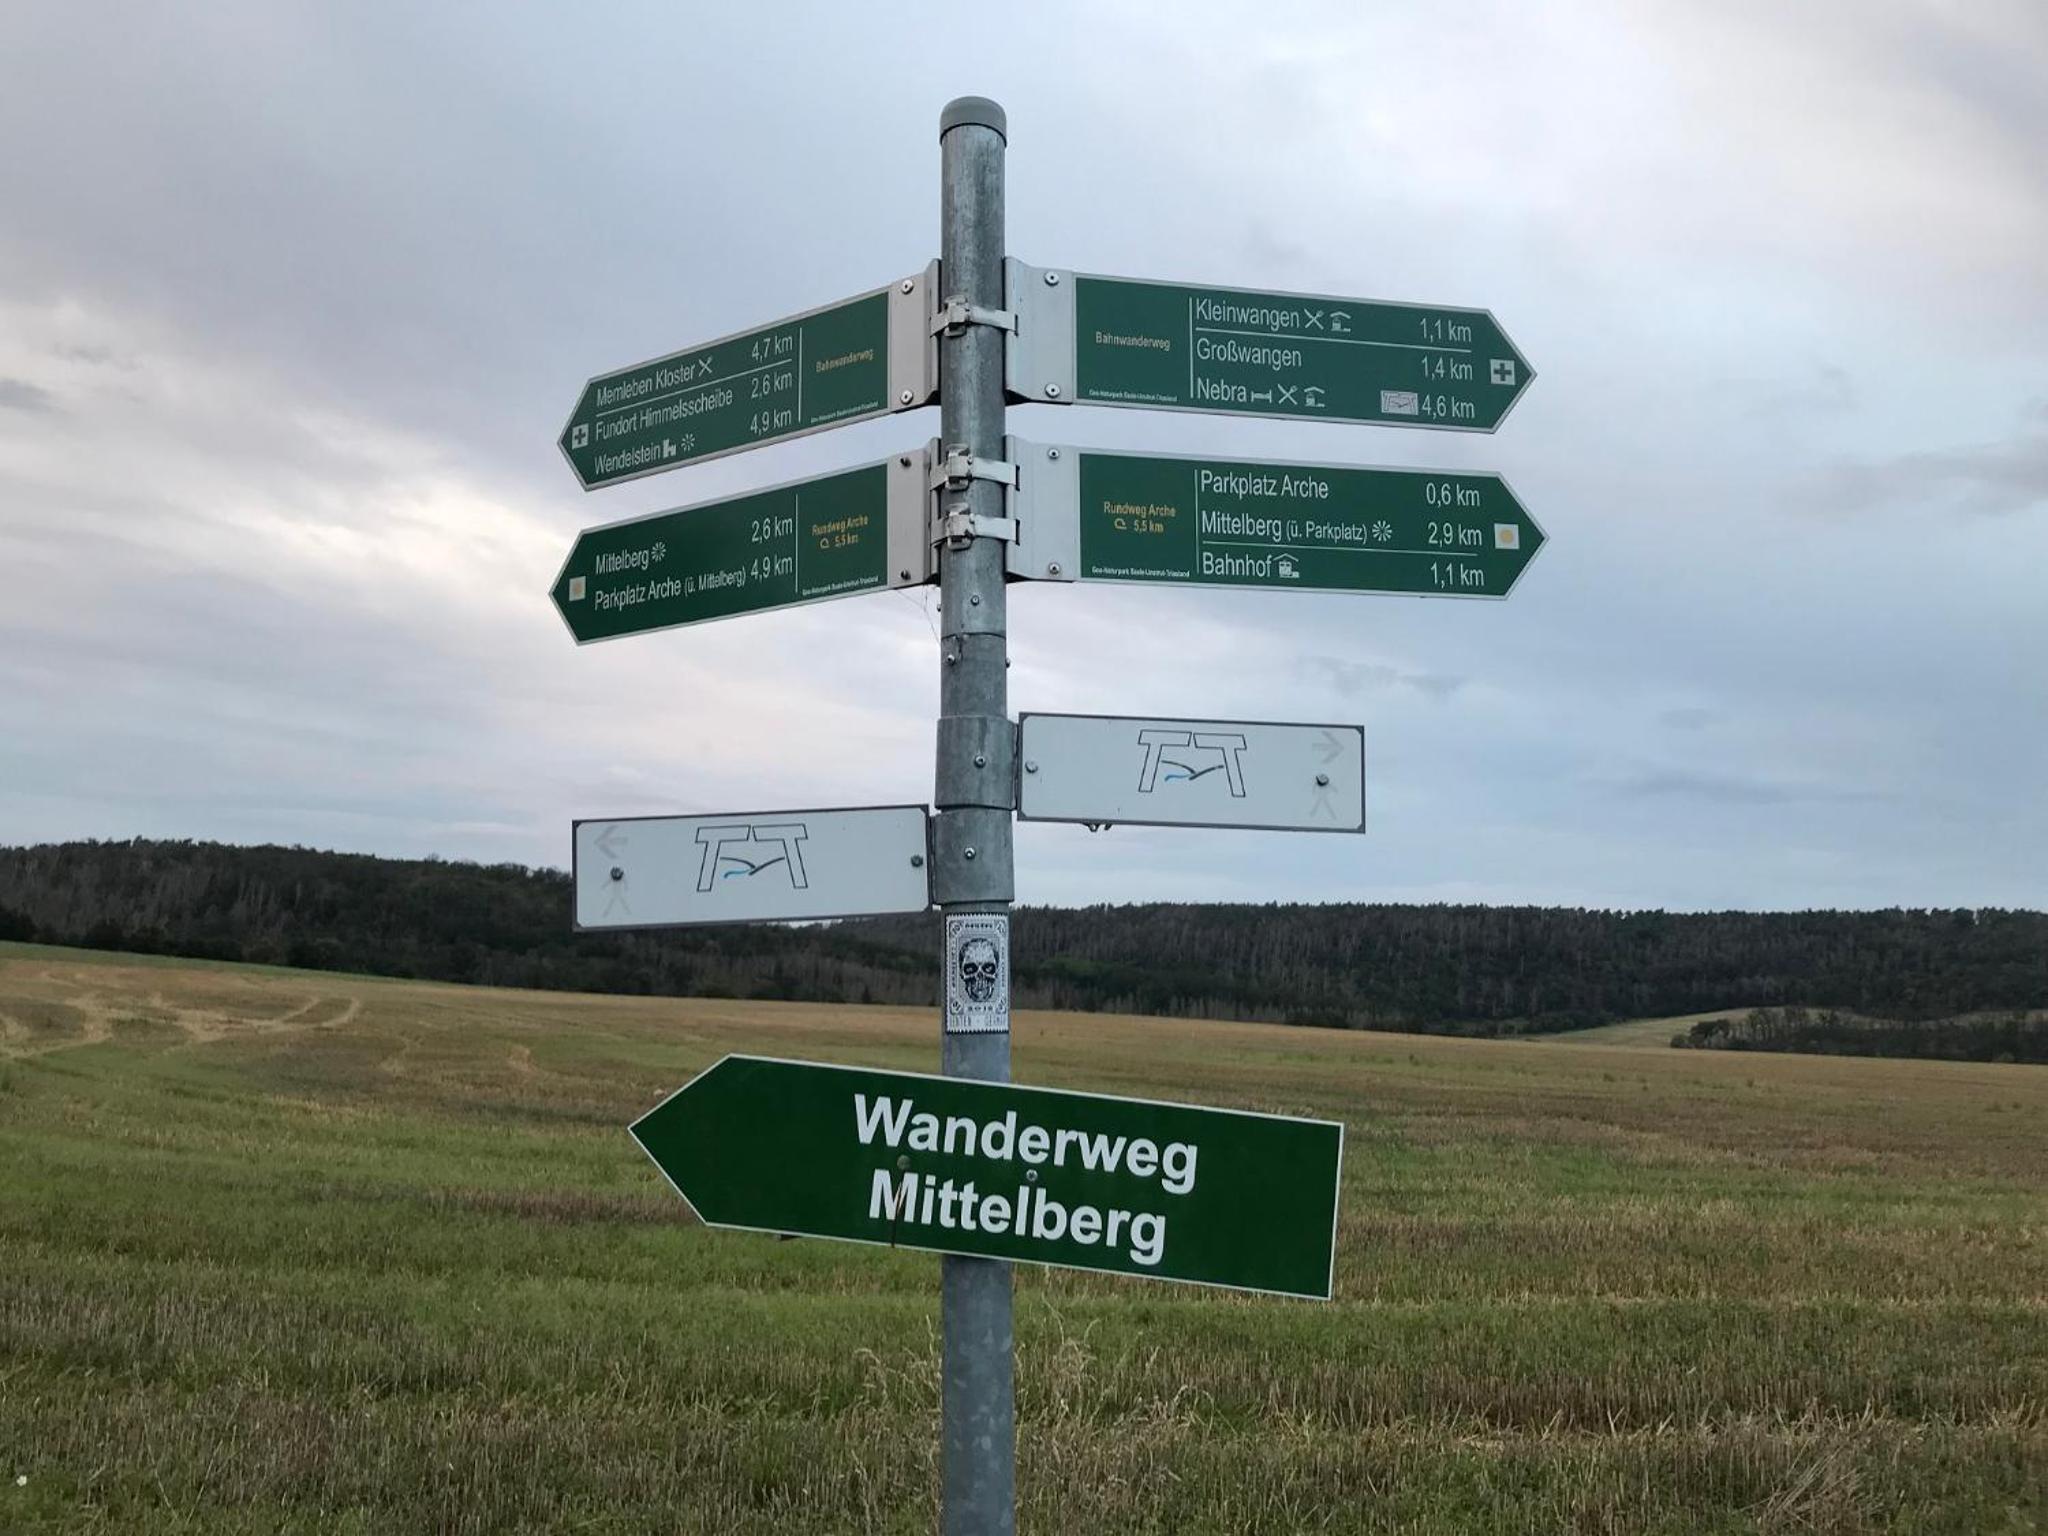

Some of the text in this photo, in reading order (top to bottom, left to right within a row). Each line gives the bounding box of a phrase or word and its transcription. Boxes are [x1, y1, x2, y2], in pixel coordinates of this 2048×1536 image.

[1095, 331, 1170, 352] Bahnwanderweg
[1196, 298, 1472, 343] Kleinwangen 1,1 km
[597, 335, 793, 407] Memleben Kloster 4,7 km
[1197, 339, 1474, 382] Großwangen 1,4 km
[595, 371, 793, 440] Fundort Himmelsscheibe 2,6 km
[1197, 378, 1247, 403] Nebra
[1421, 395, 1448, 420] 4,6
[1451, 399, 1476, 419] km
[594, 442, 661, 475] Wendelstein
[750, 410, 770, 436] 4,9
[773, 409, 792, 429] km
[1103, 501, 1177, 518] Rundweg Arche
[1201, 471, 1481, 509] Parkplatz Arche 0,6 km
[595, 516, 793, 575] Mittelberg 2,6 km
[1149, 520, 1164, 533] km
[1201, 511, 1282, 542] Mittelberg
[1305, 523, 1368, 545] Parkplatz)
[1427, 522, 1454, 548] 2,9
[1457, 524, 1483, 546] km
[594, 583, 646, 612] Parkplatz
[648, 576, 682, 600] Arche
[698, 565, 747, 591] Mittelberg)
[750, 558, 772, 582] 4,9
[773, 553, 793, 575] km
[1203, 552, 1485, 588] Bahnhof 1,1 km
[853, 1093, 1199, 1195] Wanderweg
[868, 1168, 1168, 1267] Mittelberg
